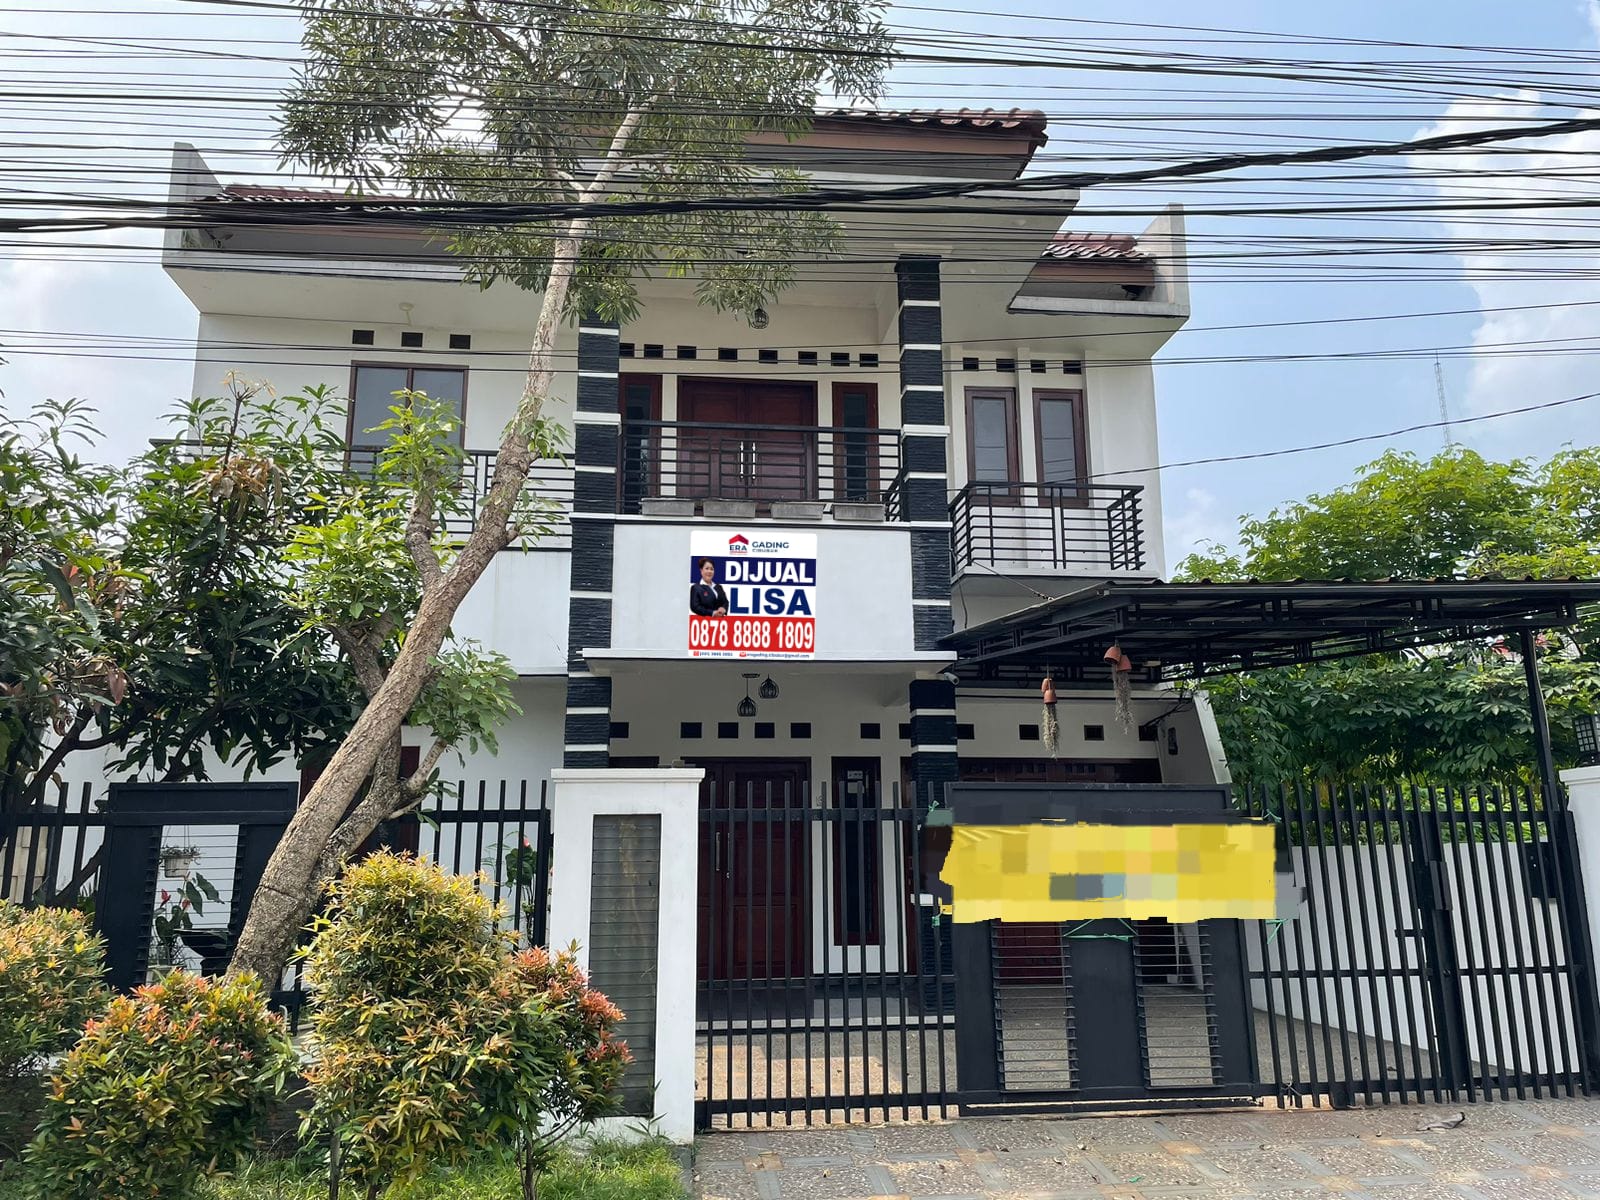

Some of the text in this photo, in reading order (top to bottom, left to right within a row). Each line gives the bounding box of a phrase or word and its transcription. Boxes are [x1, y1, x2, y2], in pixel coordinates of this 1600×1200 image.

[752, 541, 790, 549] GADING
[725, 560, 814, 583] DIJUAL
[730, 587, 812, 616] LISA
[690, 619, 814, 649] 0878 8888 1809
